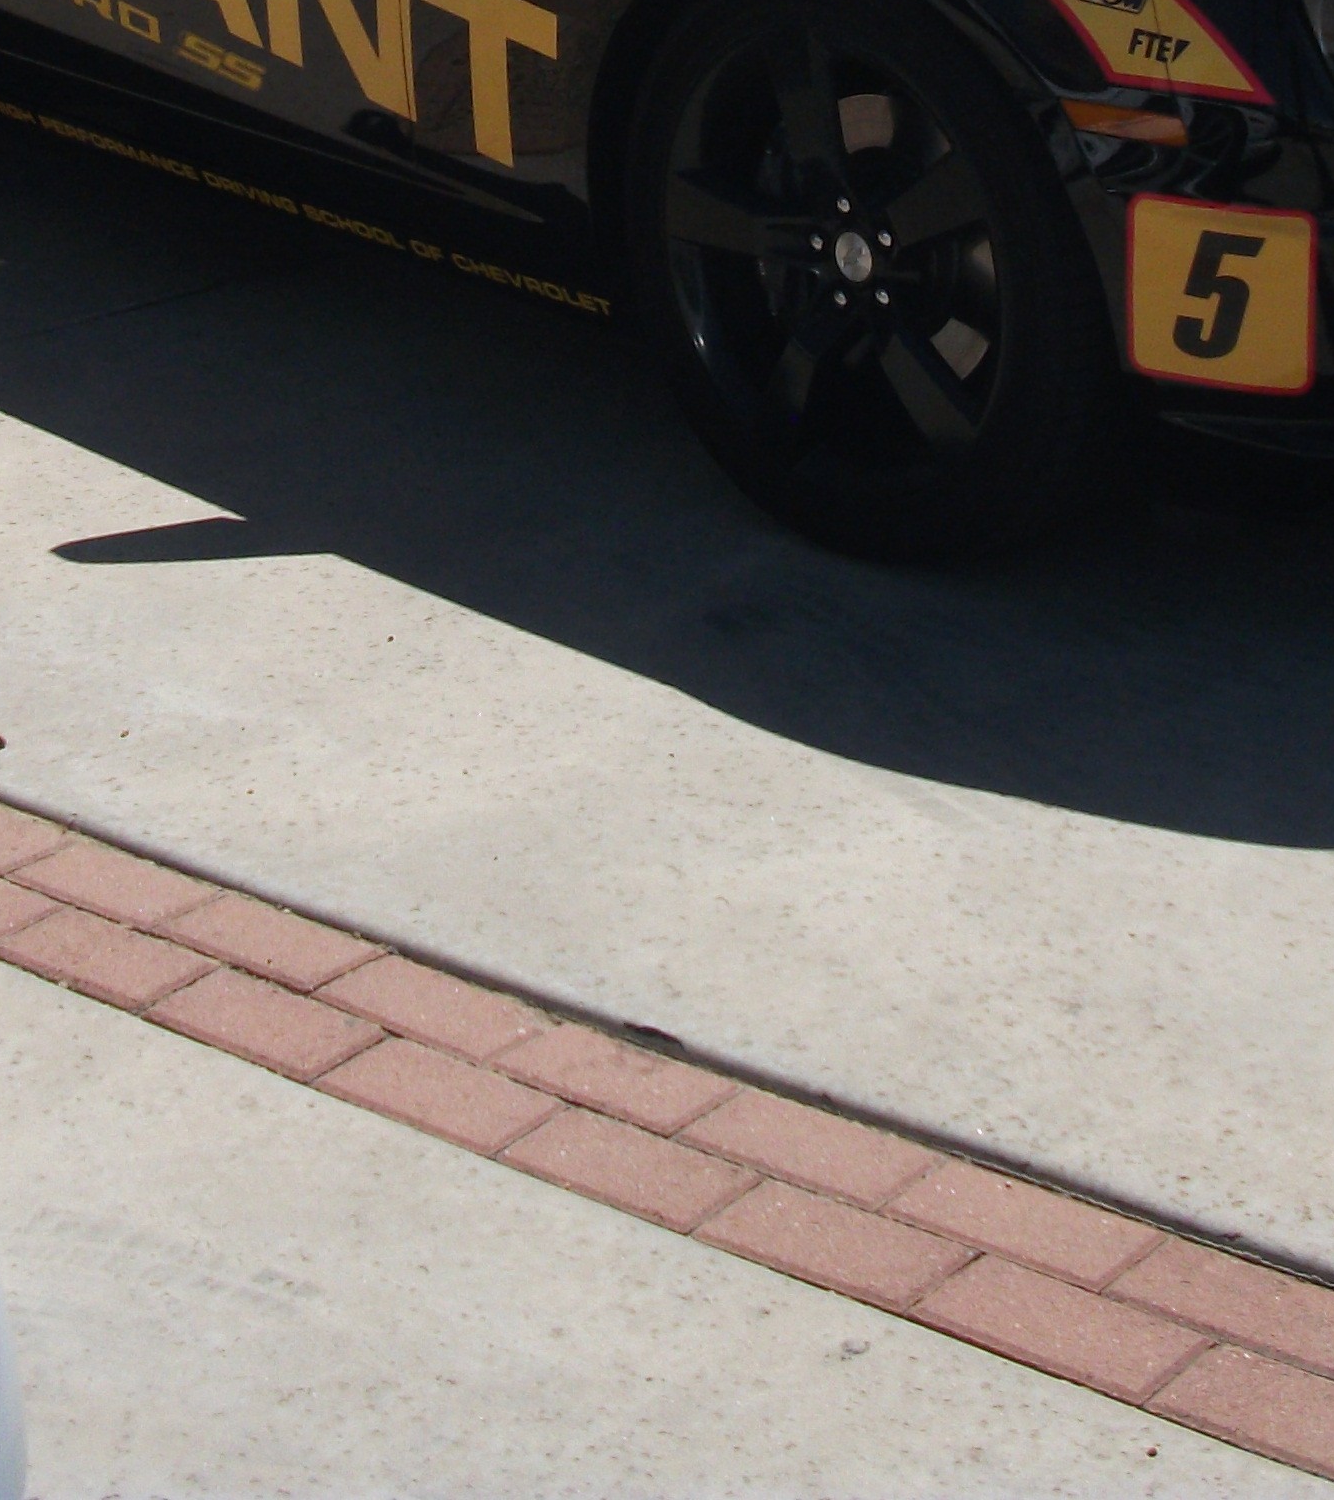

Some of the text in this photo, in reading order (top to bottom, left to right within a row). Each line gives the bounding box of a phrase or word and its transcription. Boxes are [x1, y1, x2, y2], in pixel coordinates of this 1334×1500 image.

[176, 31, 267, 92] SS
[301, 204, 406, 251] SCHOOL
[408, 239, 444, 262] OF
[451, 252, 611, 316] CHEVROLET
[1173, 230, 1266, 359] 5
